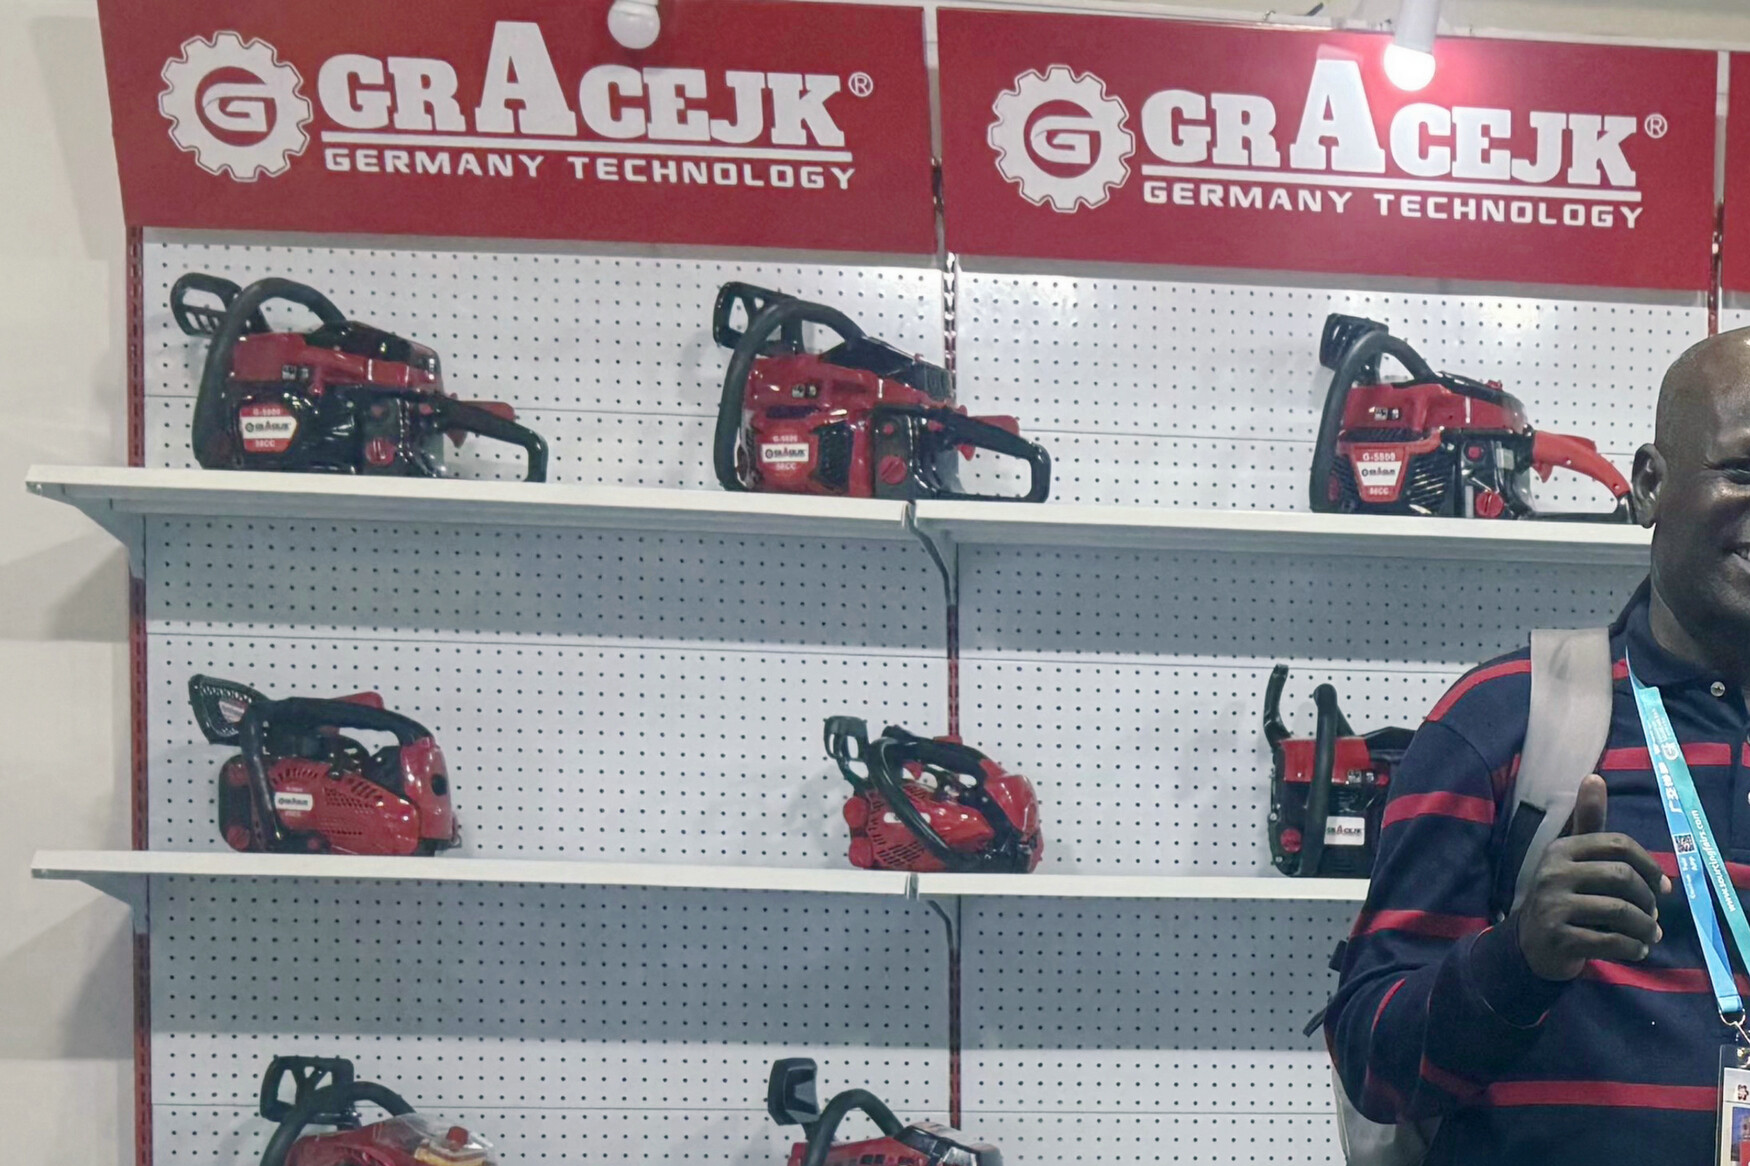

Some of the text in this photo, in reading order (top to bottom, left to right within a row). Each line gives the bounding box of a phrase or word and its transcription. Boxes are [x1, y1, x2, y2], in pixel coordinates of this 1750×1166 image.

[325, 147, 855, 190] GERMANY TECHNOLOGY
[1144, 182, 1643, 228] GERMANY TECHNOLOGY
